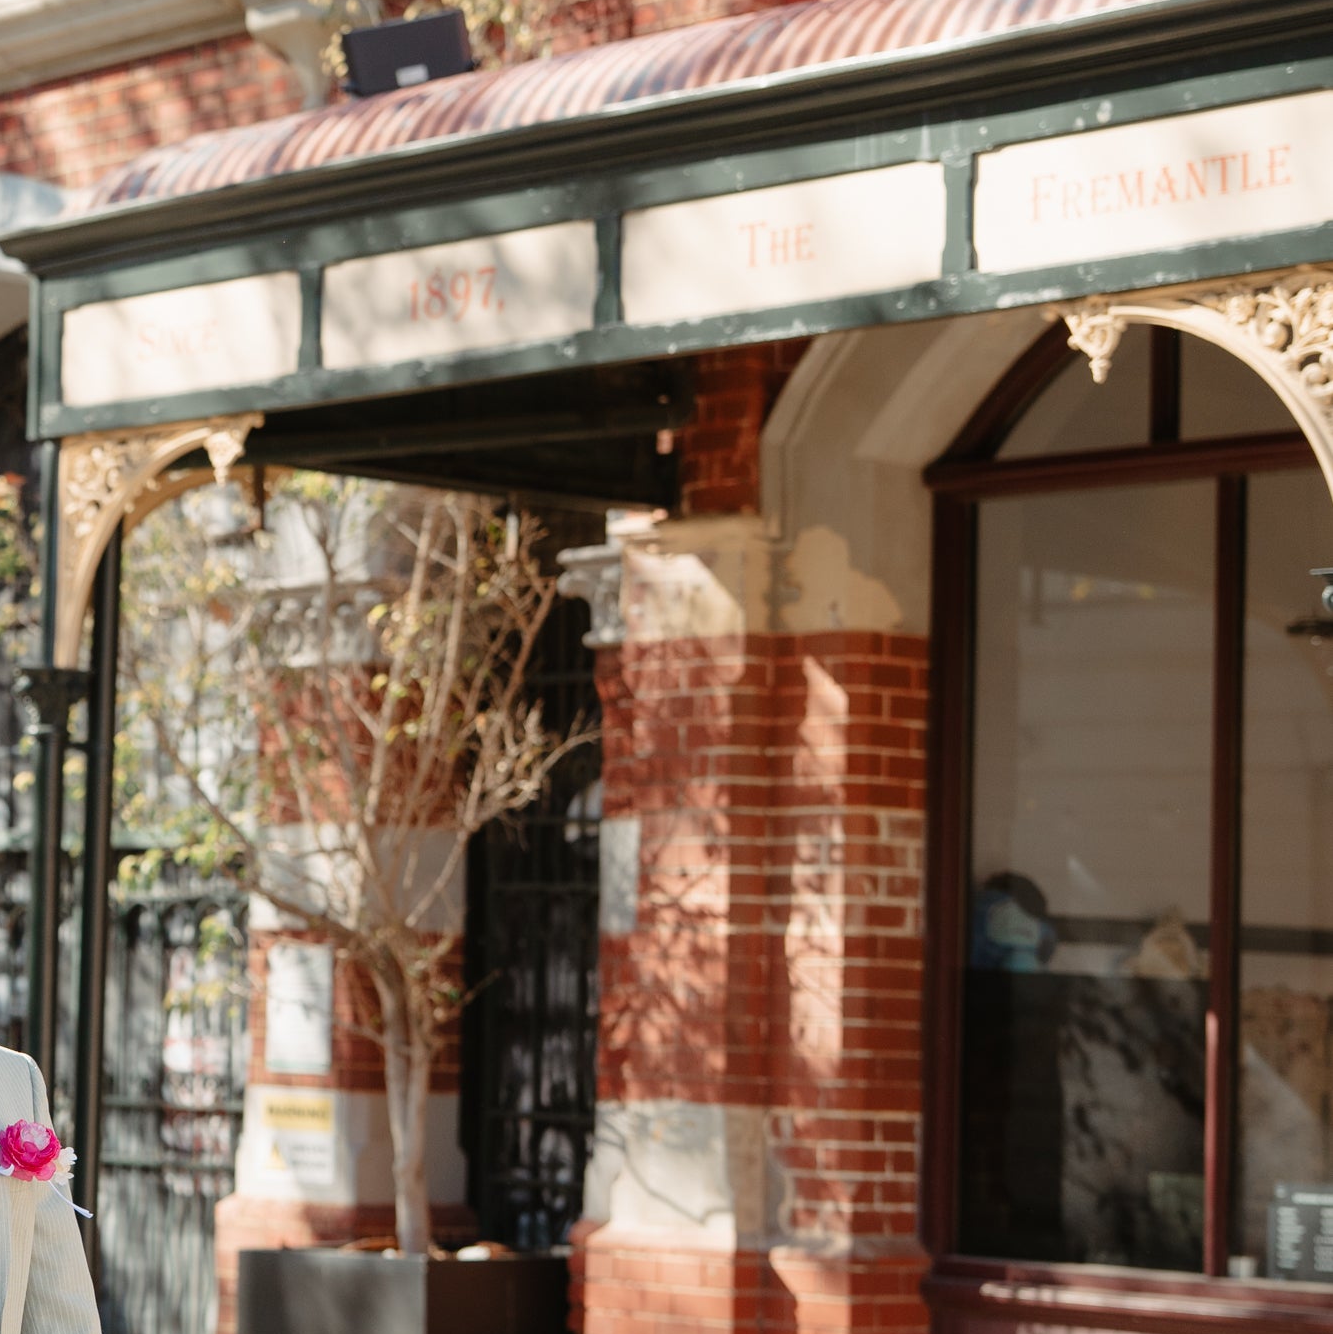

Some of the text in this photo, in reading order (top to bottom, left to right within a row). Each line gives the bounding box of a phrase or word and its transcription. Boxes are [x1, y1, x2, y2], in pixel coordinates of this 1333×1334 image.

[137, 318, 219, 360] SINCE
[739, 221, 815, 268] THE
[1030, 143, 1293, 222] FREMANTLE
